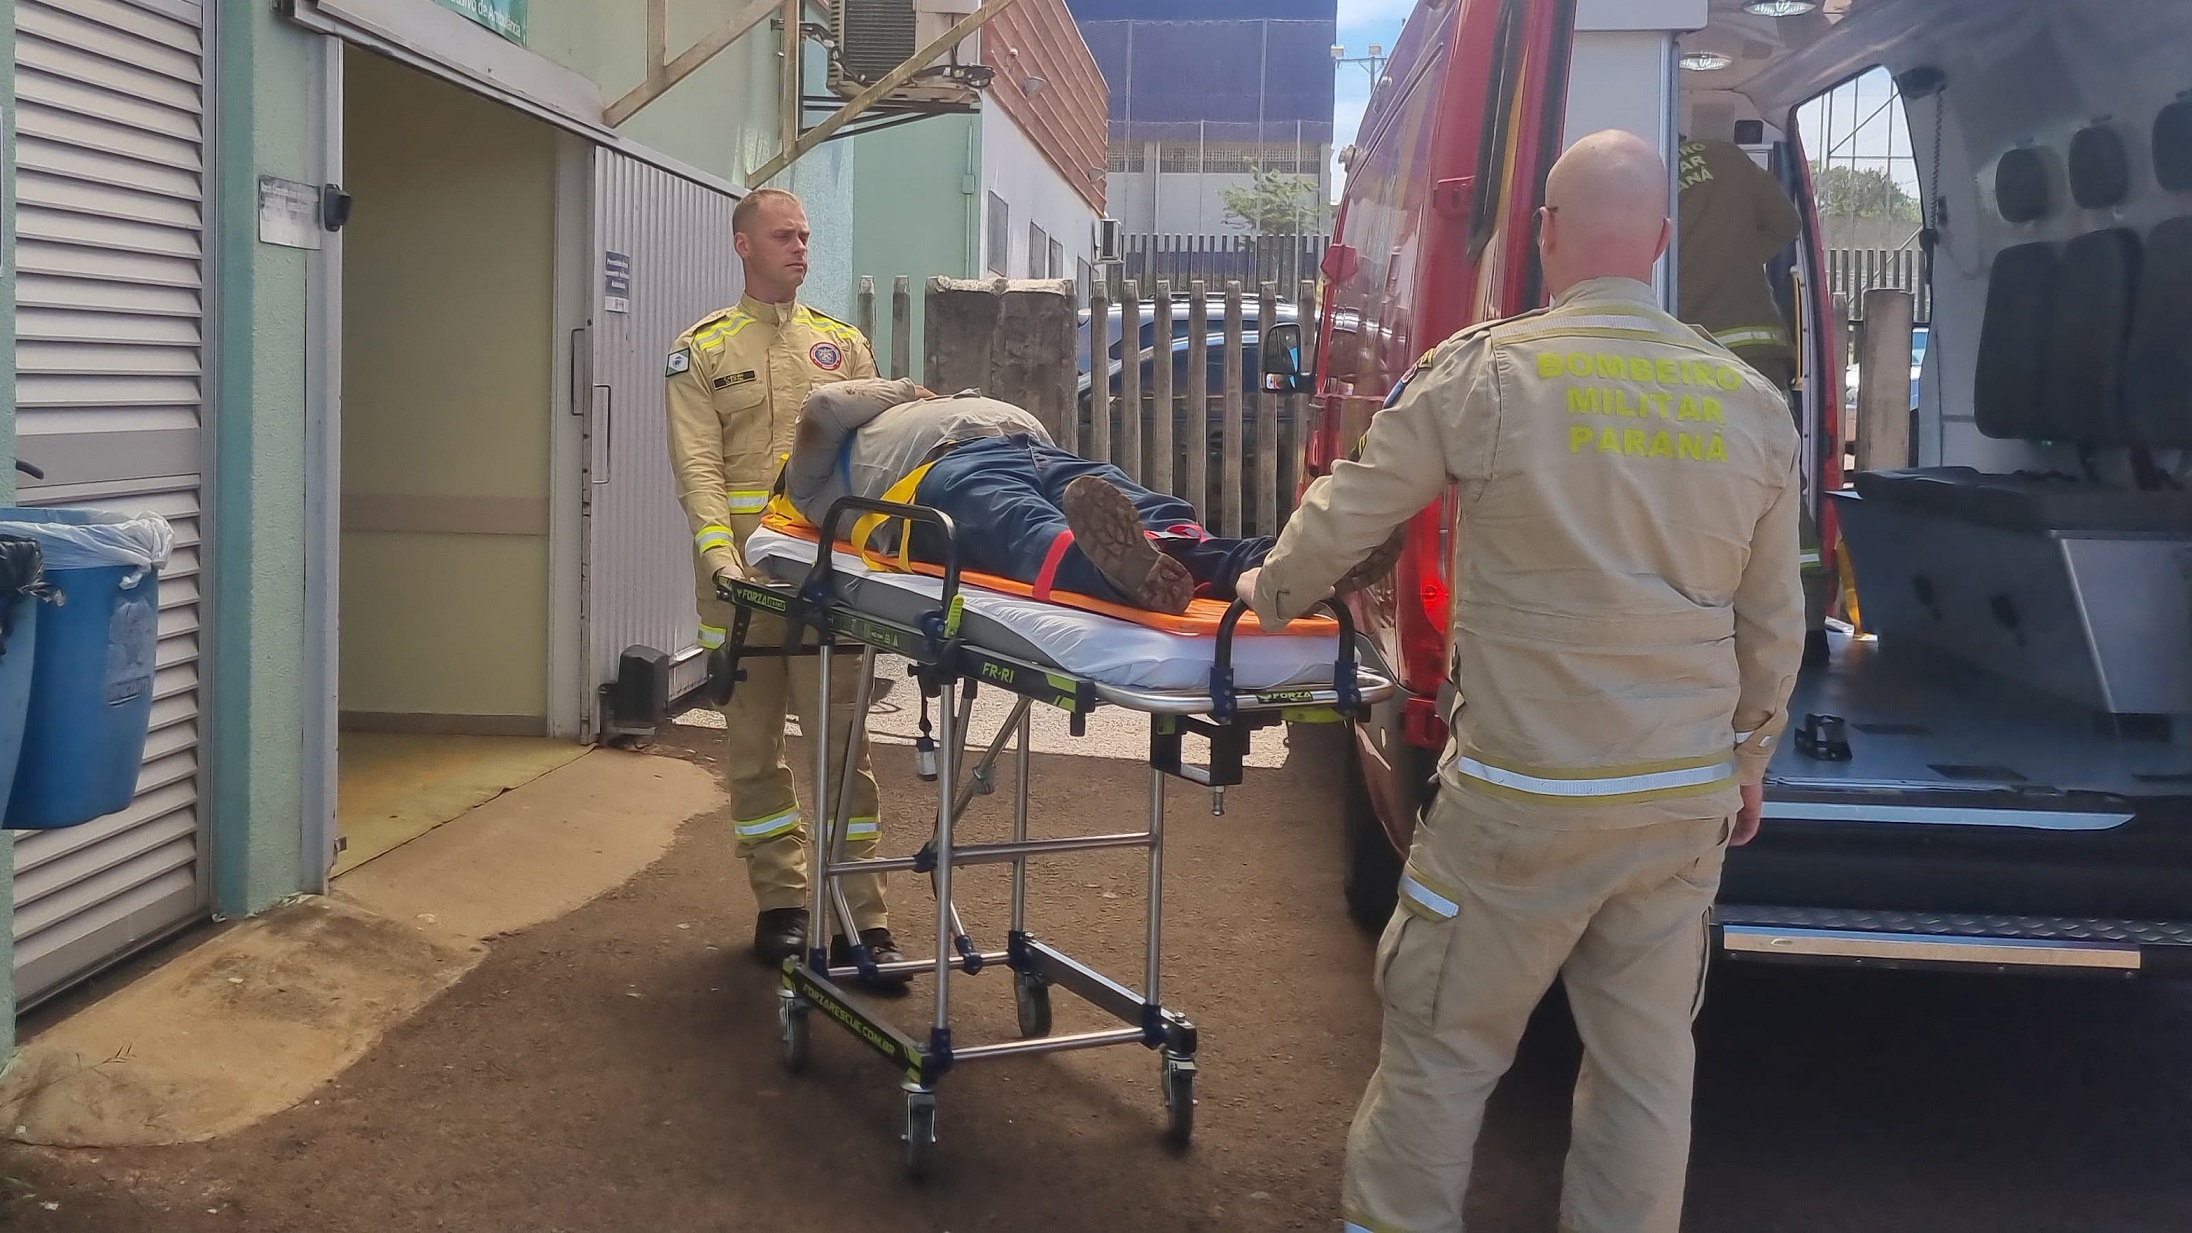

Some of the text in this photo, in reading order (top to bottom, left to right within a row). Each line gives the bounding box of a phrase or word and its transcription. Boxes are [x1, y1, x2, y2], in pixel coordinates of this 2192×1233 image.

[477, 0, 488, 18] de
[1537, 352, 1742, 391] BOMBEIRO
[1566, 386, 1725, 425] MILITAR
[1568, 424, 1728, 463] PARANÁ
[742, 588, 768, 606] FORZA
[1272, 691, 1311, 699] FORZA
